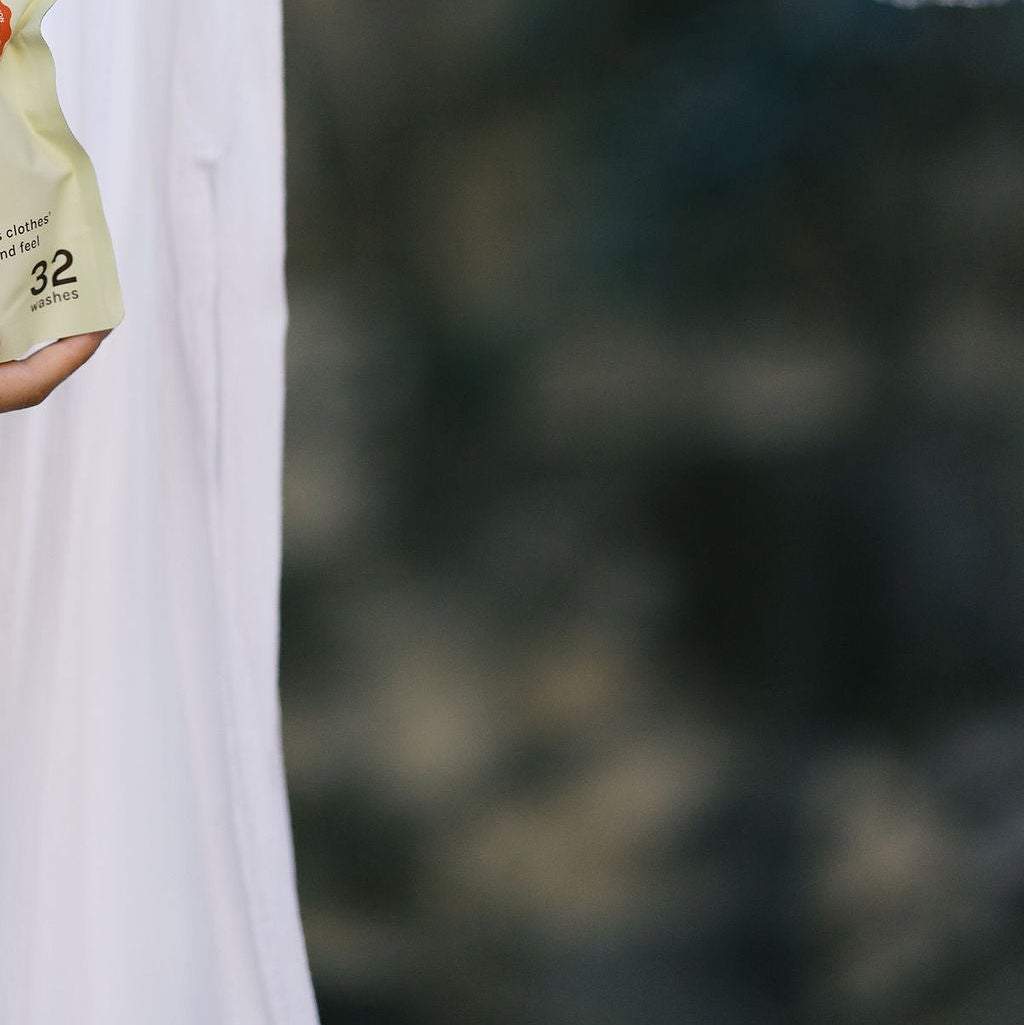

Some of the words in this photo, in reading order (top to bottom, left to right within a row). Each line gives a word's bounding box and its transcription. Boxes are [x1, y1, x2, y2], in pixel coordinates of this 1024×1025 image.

[20, 235, 41, 254] feel
[29, 248, 78, 297] 32
[29, 287, 80, 313] washes
